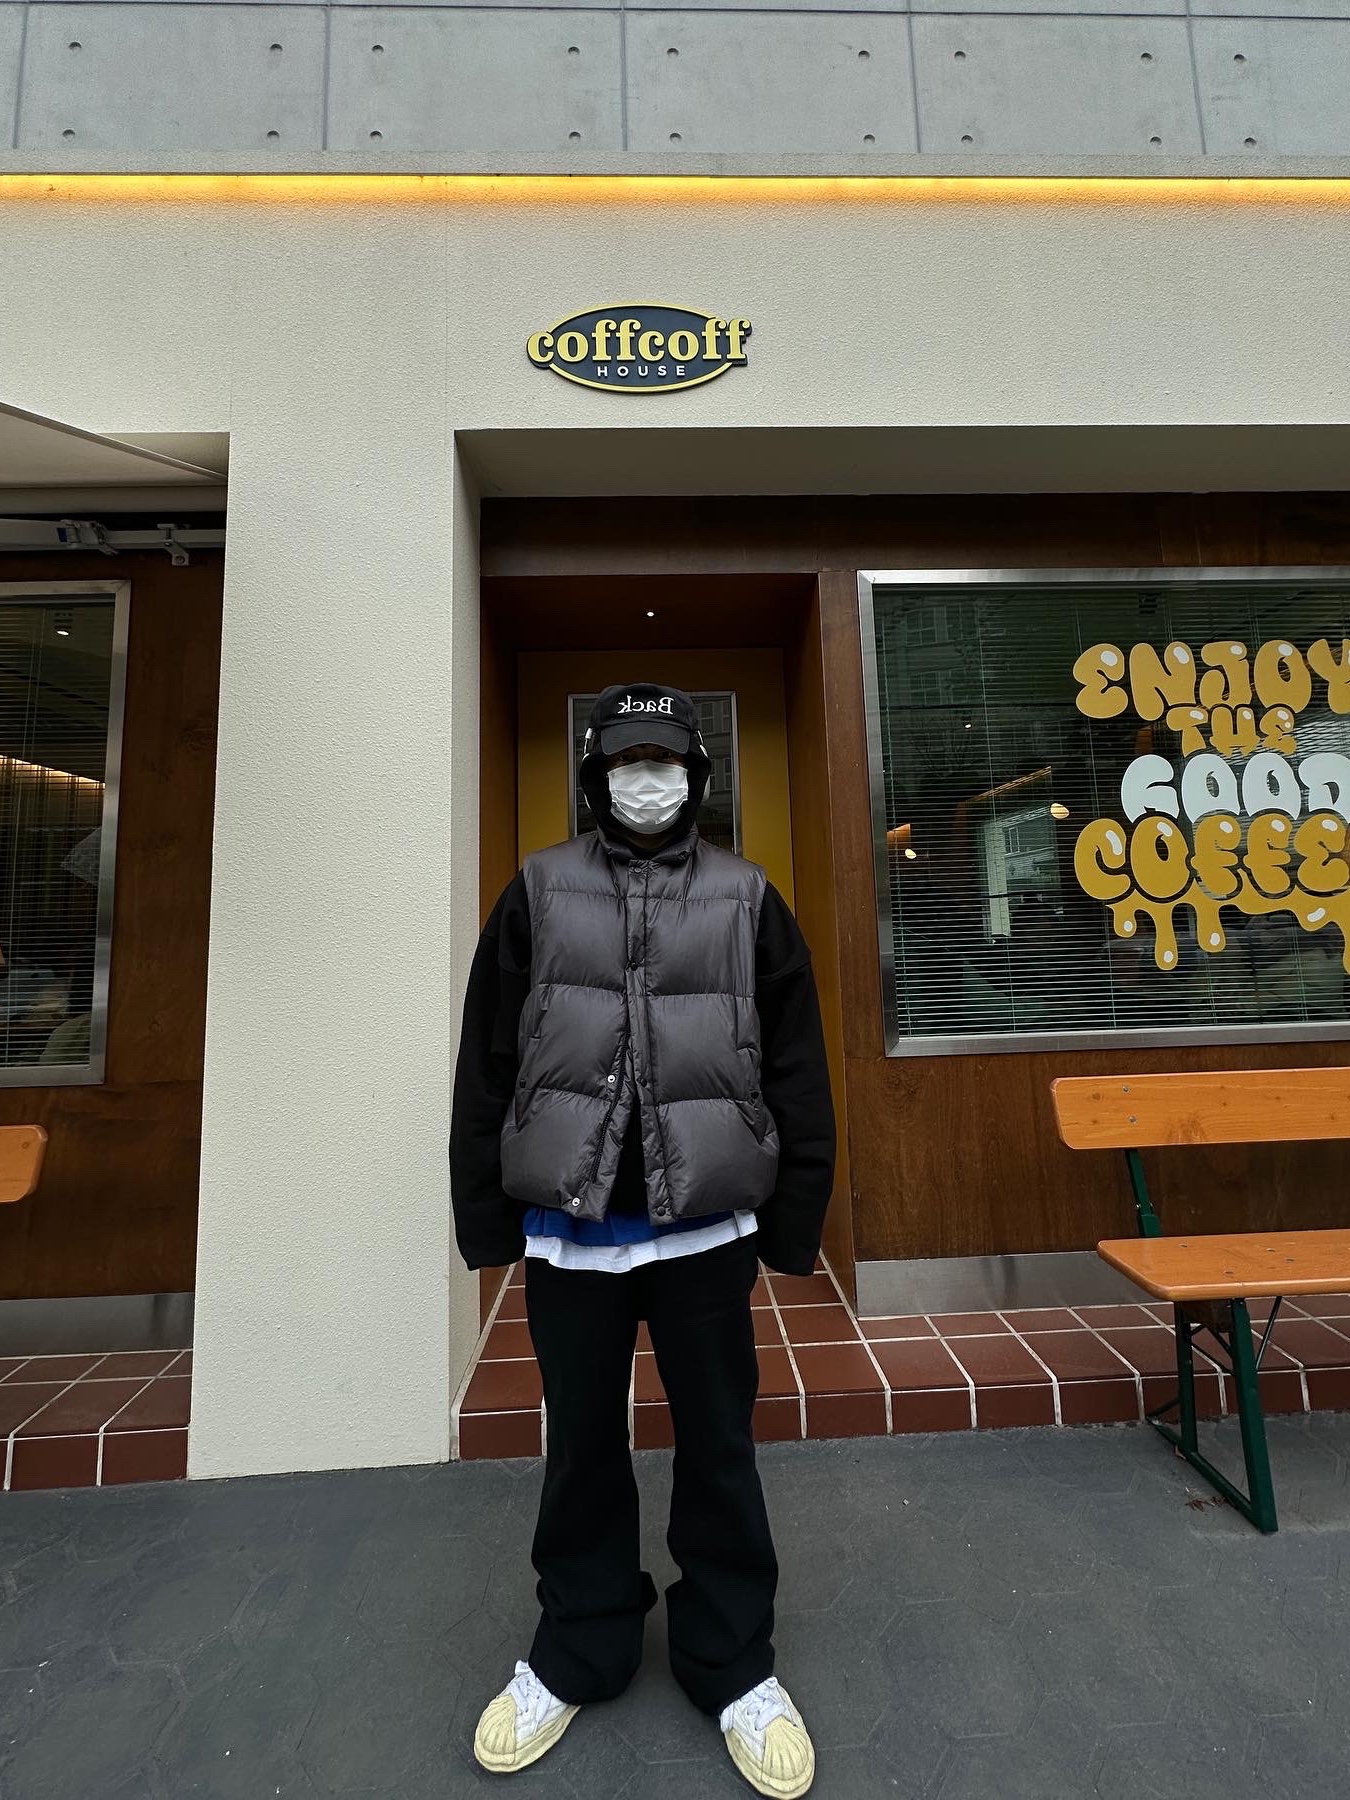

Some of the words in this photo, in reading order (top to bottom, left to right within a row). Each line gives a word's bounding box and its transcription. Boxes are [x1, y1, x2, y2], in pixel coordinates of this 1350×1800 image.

[527, 319, 751, 363] coffcoff
[597, 365, 686, 377] HOUSE
[1072, 638, 1350, 721] ENJOY
[1165, 706, 1298, 758] THE
